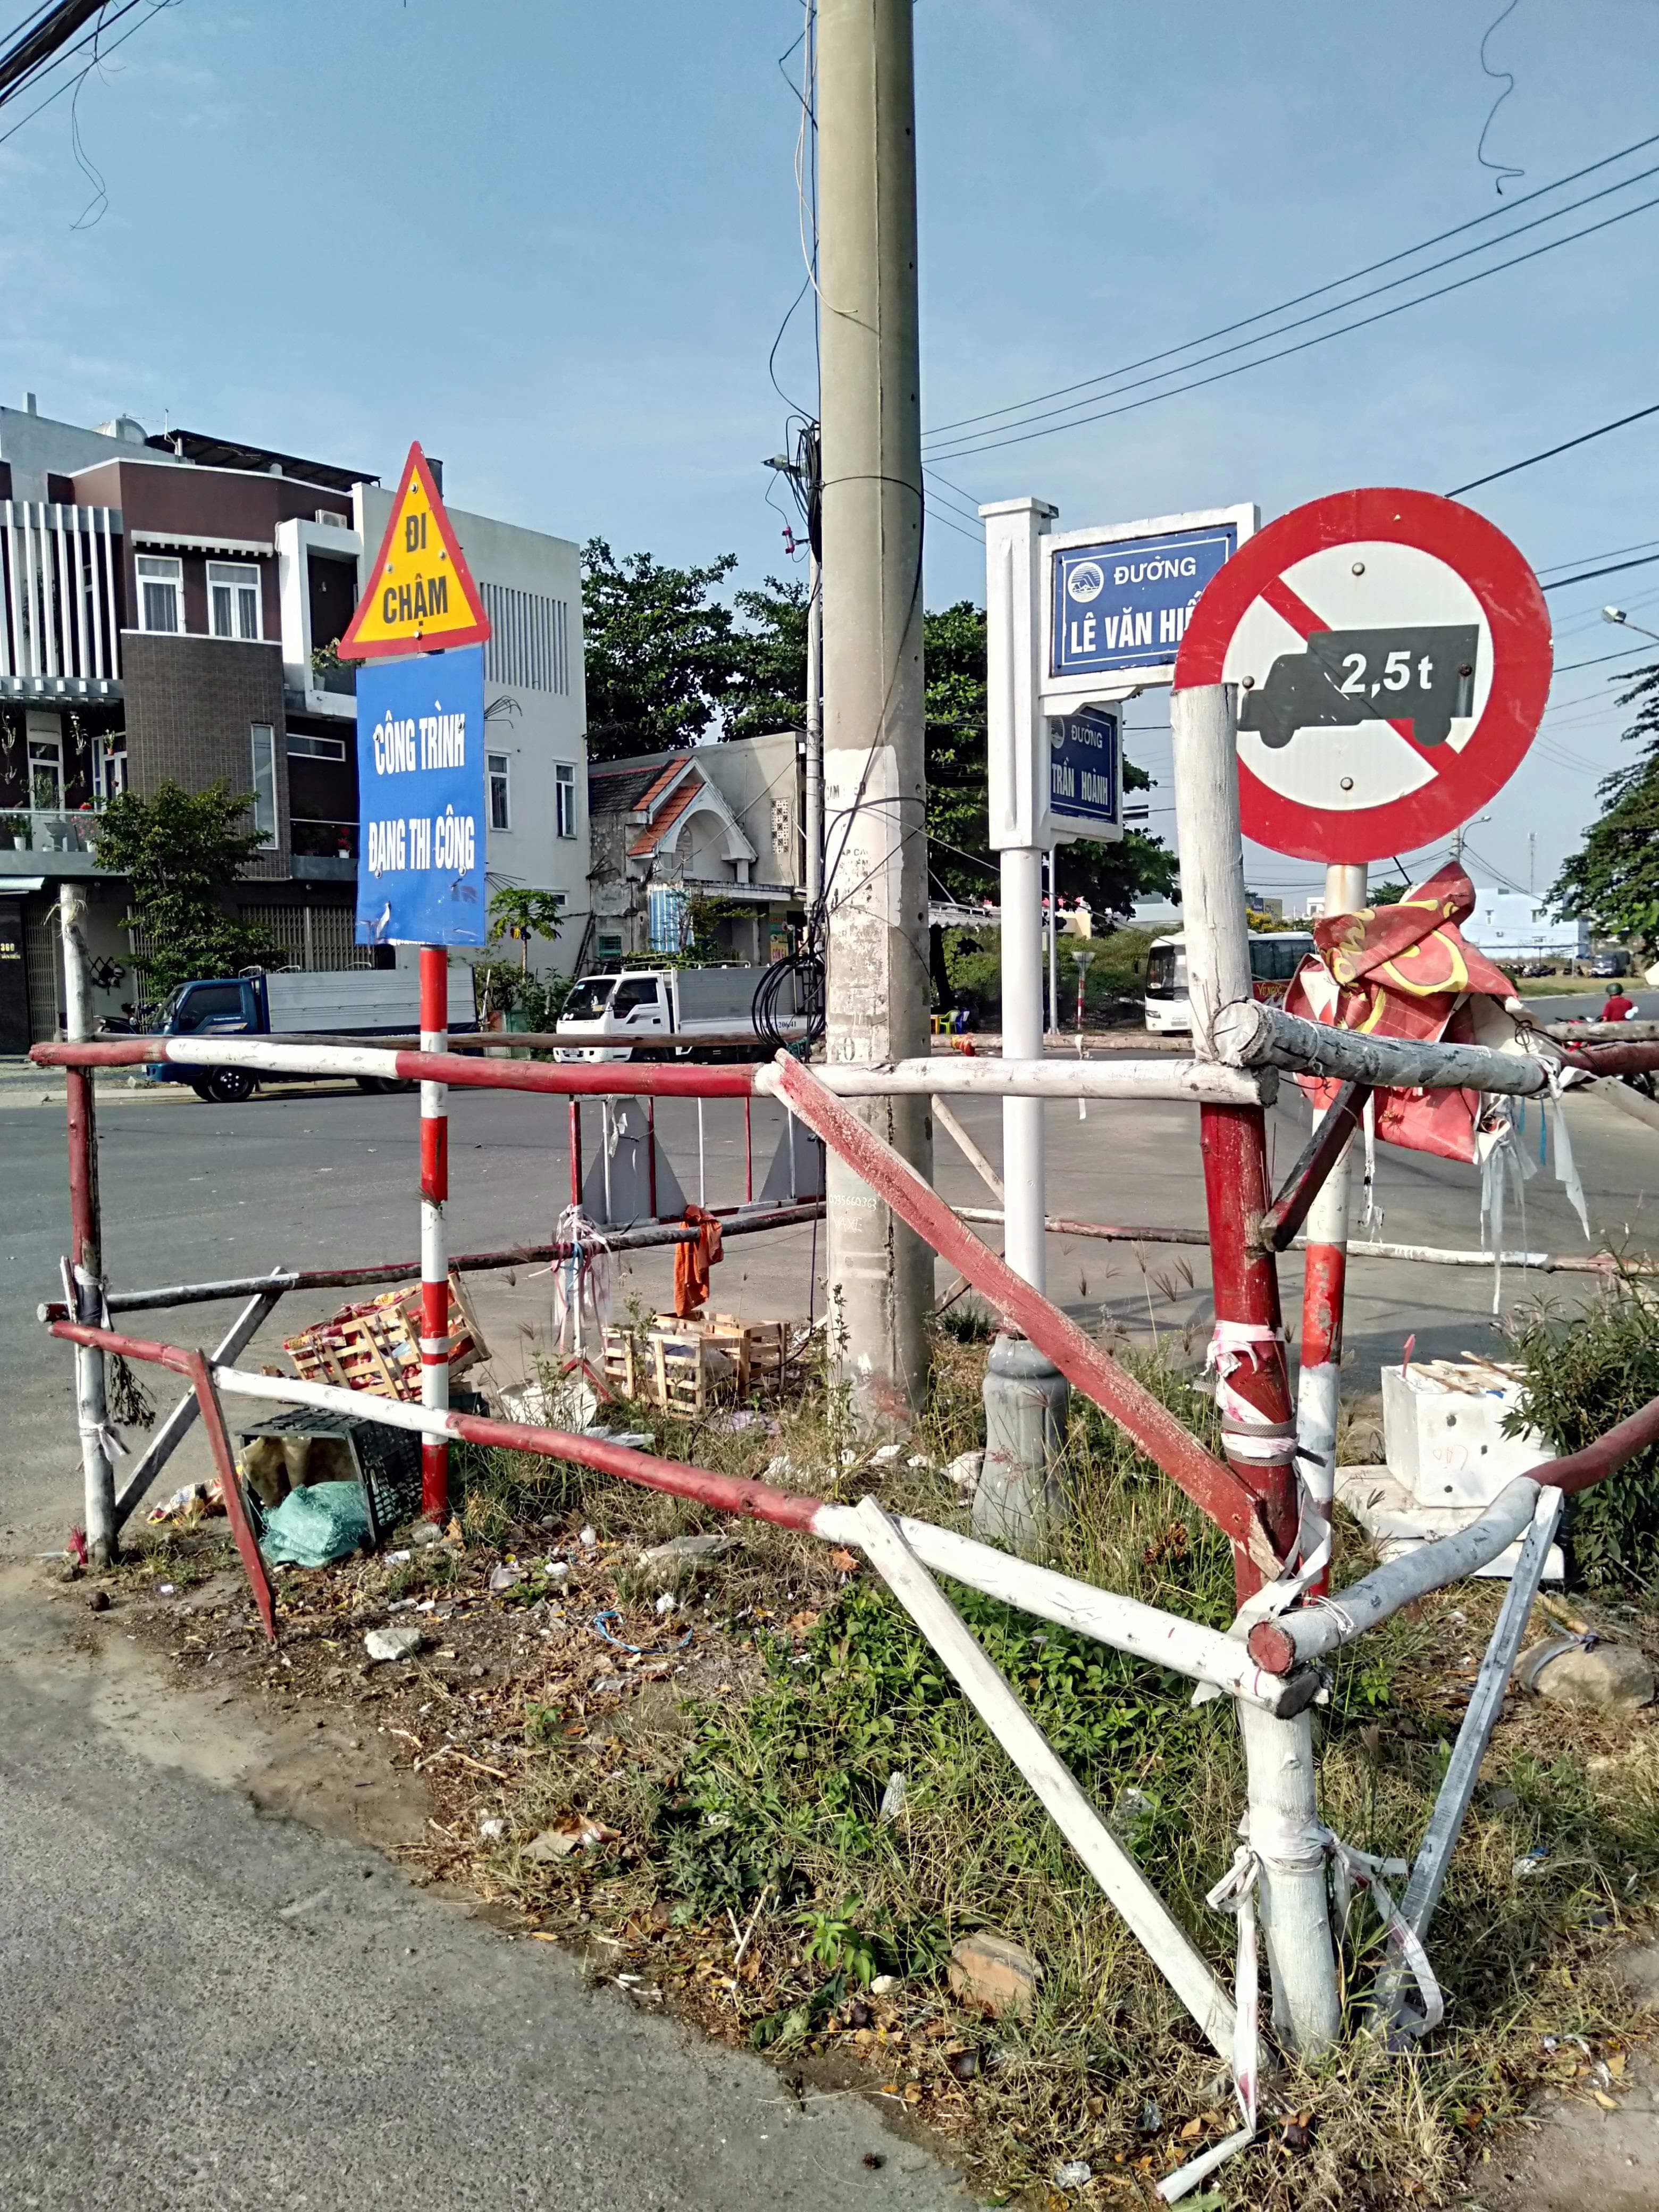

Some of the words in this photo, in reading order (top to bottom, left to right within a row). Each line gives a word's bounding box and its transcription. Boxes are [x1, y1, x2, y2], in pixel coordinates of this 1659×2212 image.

[405, 512, 427, 553] ĐI
[1113, 555, 1196, 585] ĐƯỜNG
[383, 573, 448, 626] CHẬM
[1070, 611, 1096, 655] LÊ
[1105, 606, 1153, 650] VĂN
[374, 710, 416, 775] CÔNG
[419, 700, 466, 770] TRÌNH
[1071, 724, 1103, 749] ĐƯỜNG
[1052, 757, 1075, 798] TRẦN
[1081, 768, 1108, 806] HOÀNH
[368, 819, 406, 872] ĐANG
[409, 818, 431, 870] THI
[434, 803, 475, 869] CÔNG
